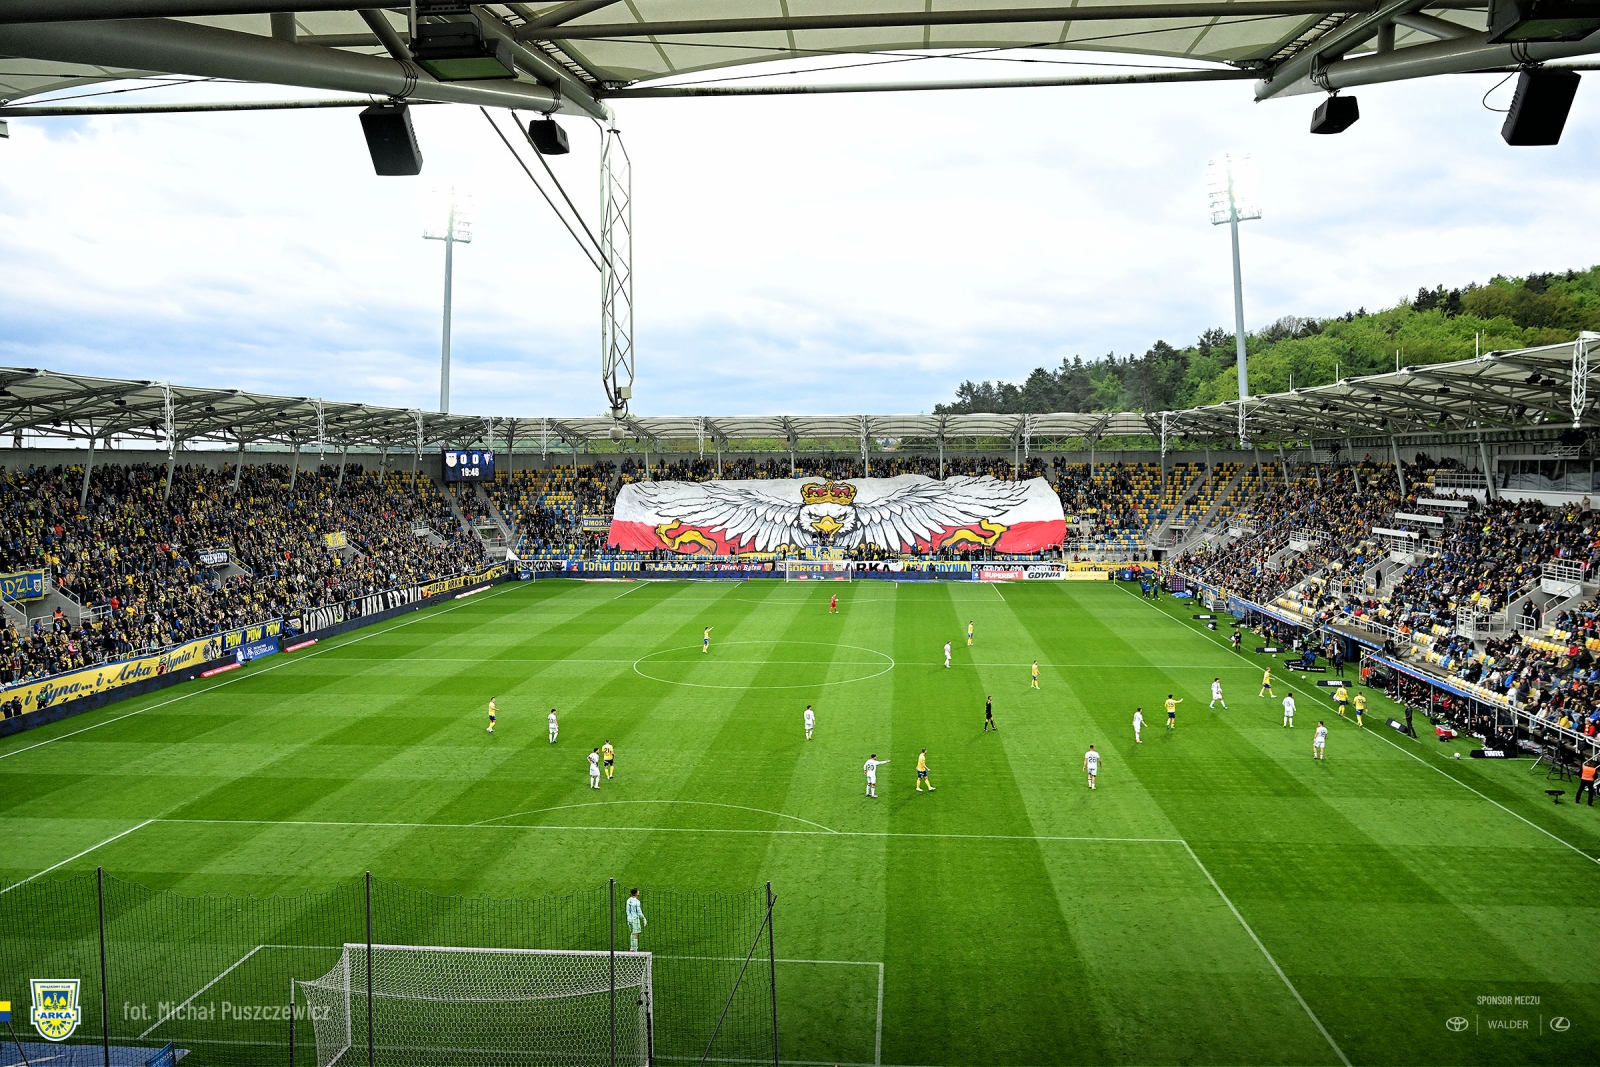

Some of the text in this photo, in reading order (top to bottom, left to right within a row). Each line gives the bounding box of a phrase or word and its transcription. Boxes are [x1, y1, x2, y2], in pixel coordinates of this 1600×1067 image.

[460, 454, 479, 465] 0 0
[935, 563, 967, 573] GDYNIA
[984, 571, 1019, 579] SUPERBET
[1027, 571, 1061, 579] GDYNIA
[361, 594, 384, 617] ARKA
[225, 630, 243, 648] POW
[246, 625, 262, 643] POW
[266, 621, 281, 637] POW
[107, 661, 153, 684] Arka
